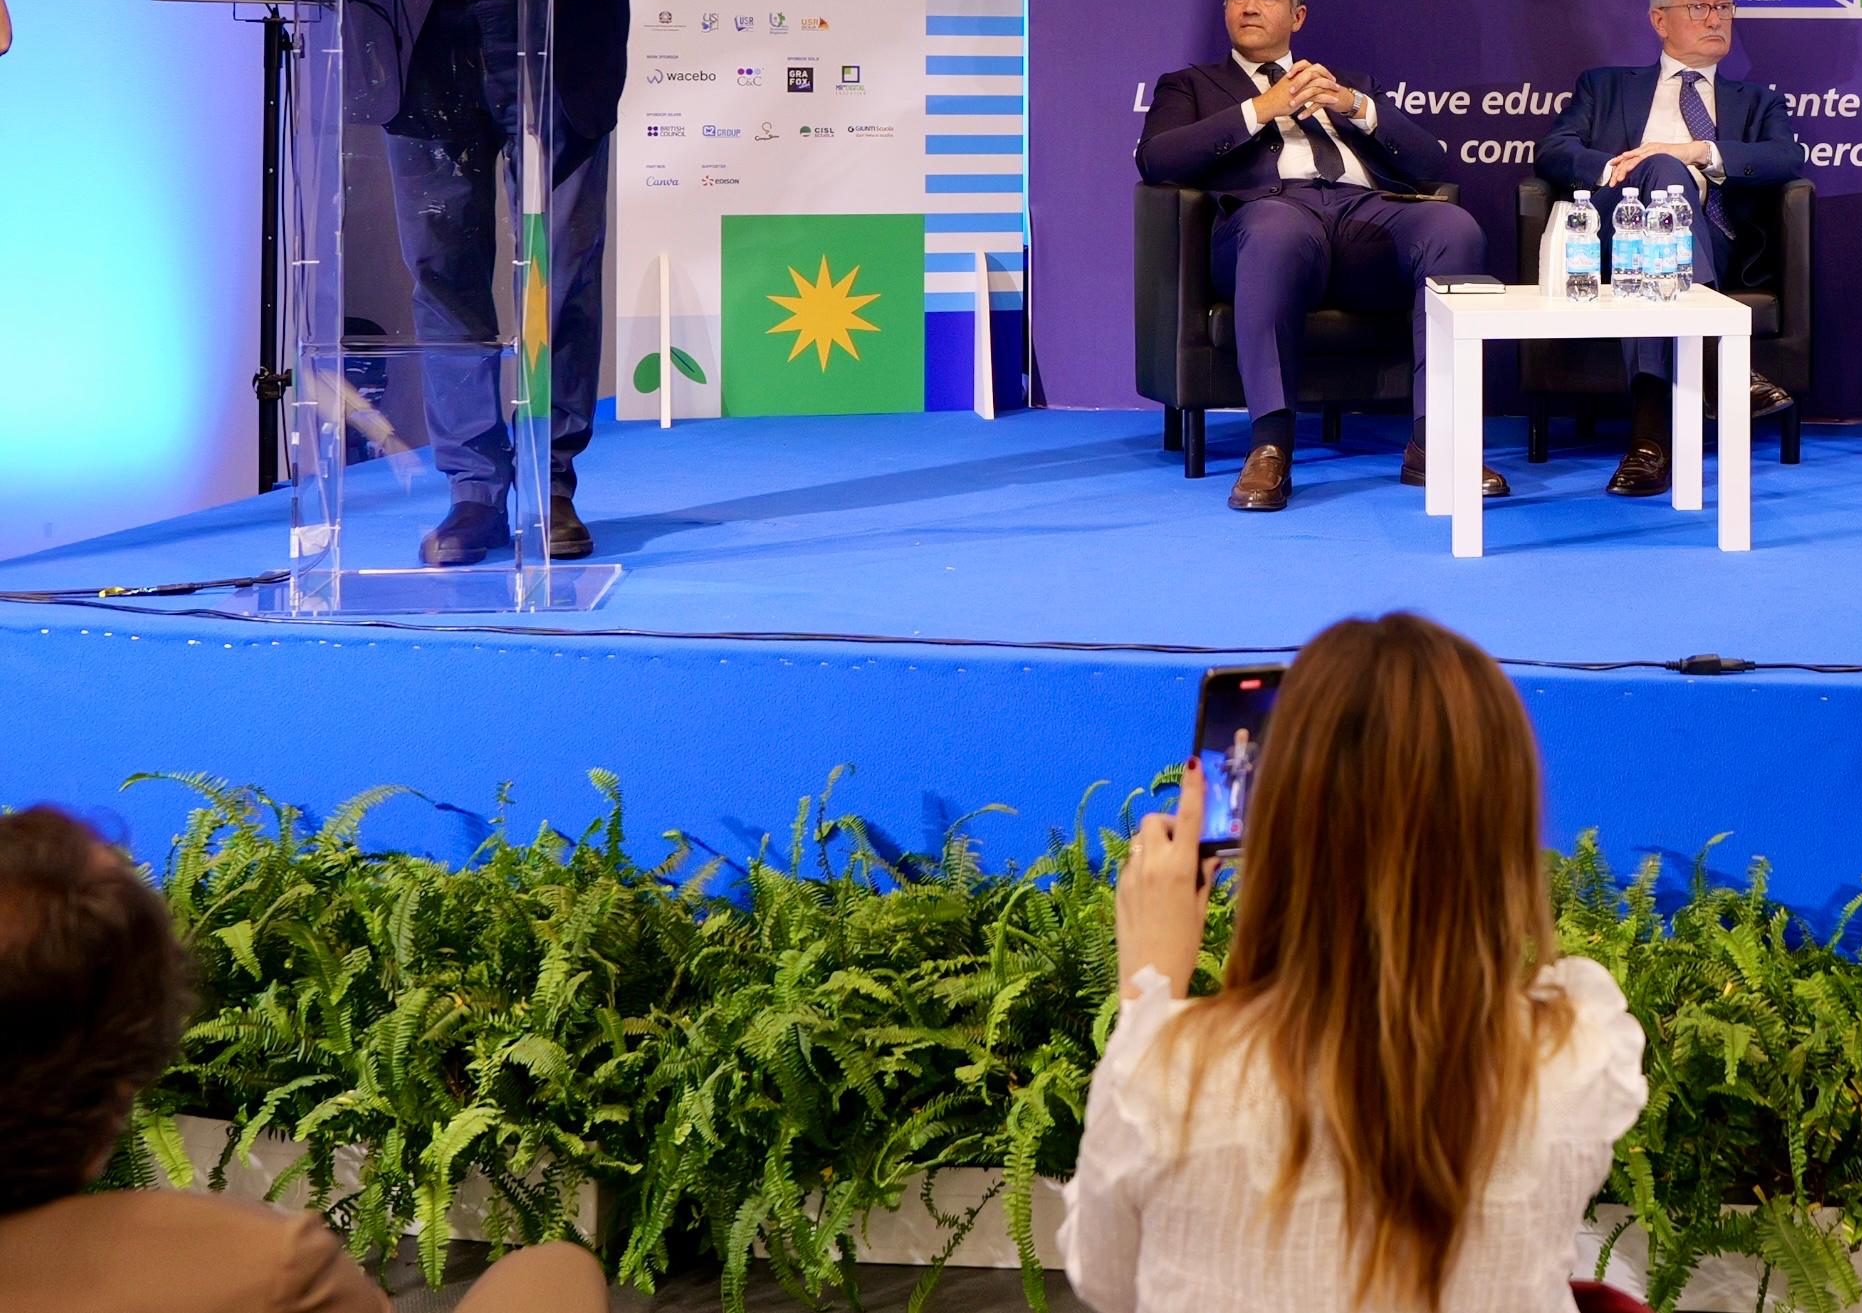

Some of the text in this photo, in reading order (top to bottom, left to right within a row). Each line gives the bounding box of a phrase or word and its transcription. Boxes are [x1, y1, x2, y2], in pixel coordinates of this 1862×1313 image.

[667, 70, 716, 81] wacebo
[1769, 84, 1860, 119] ente
[646, 176, 679, 187] Canva
